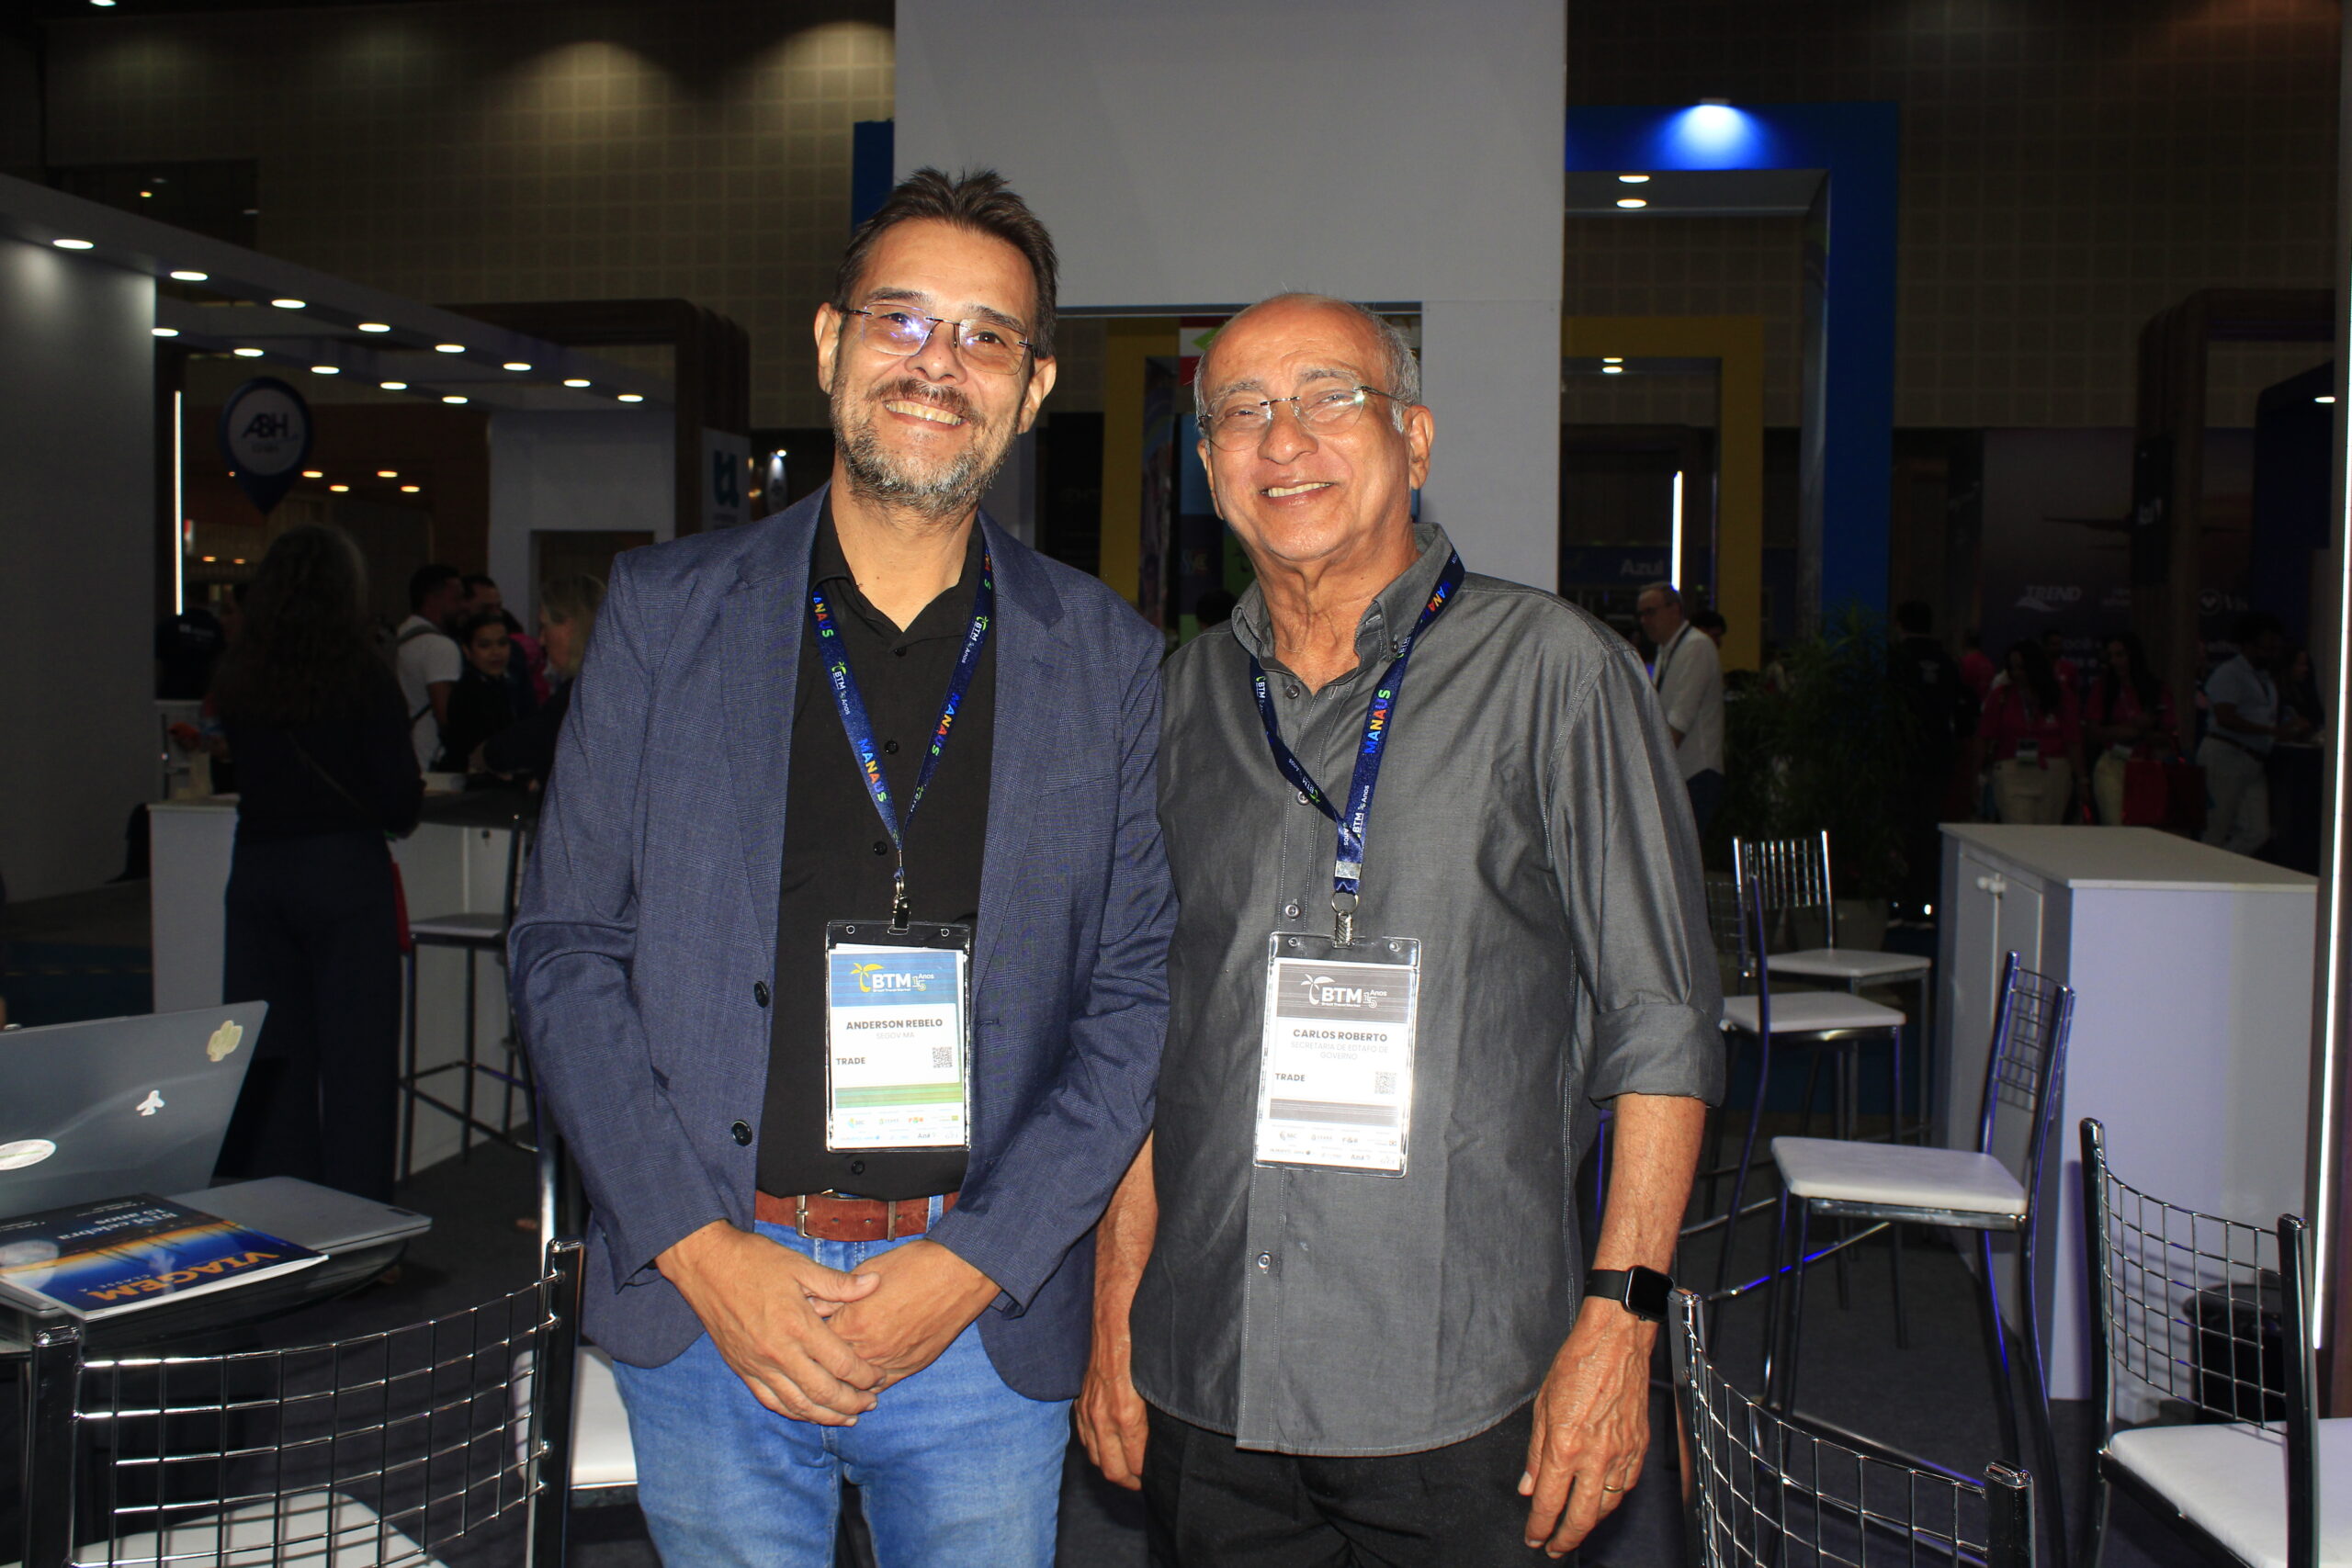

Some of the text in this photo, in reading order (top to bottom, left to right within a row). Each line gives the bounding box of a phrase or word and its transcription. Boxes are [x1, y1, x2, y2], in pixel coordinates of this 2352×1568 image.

[1620, 558, 1664, 576] Azul
[2026, 585, 2083, 602] TREND
[970, 622, 982, 642] BTM
[834, 671, 846, 690] BTM
[842, 699, 851, 716] Anos
[1258, 682, 1267, 699] BTM
[931, 693, 962, 757] MANAUS
[1363, 689, 1391, 754] MANAUS
[858, 738, 888, 802] MANAUS
[1352, 812, 1363, 833] BTM
[1361, 784, 1370, 803] Anos
[872, 973, 911, 988] BTM
[1321, 987, 1363, 1003] BTM
[846, 1019, 943, 1030] ANDERSON REBELO
[1293, 1029, 1387, 1043] CARLOS ROBERTO
[836, 1057, 866, 1066] TRADE
[1319, 1052, 1358, 1060] GOVERNO
[1274, 1073, 1306, 1082] TRADE
[131, 1211, 179, 1225] BTM
[56, 1222, 130, 1240] celebra
[86, 1251, 280, 1301] VIAGEM
[97, 1274, 152, 1290] CLASSE
